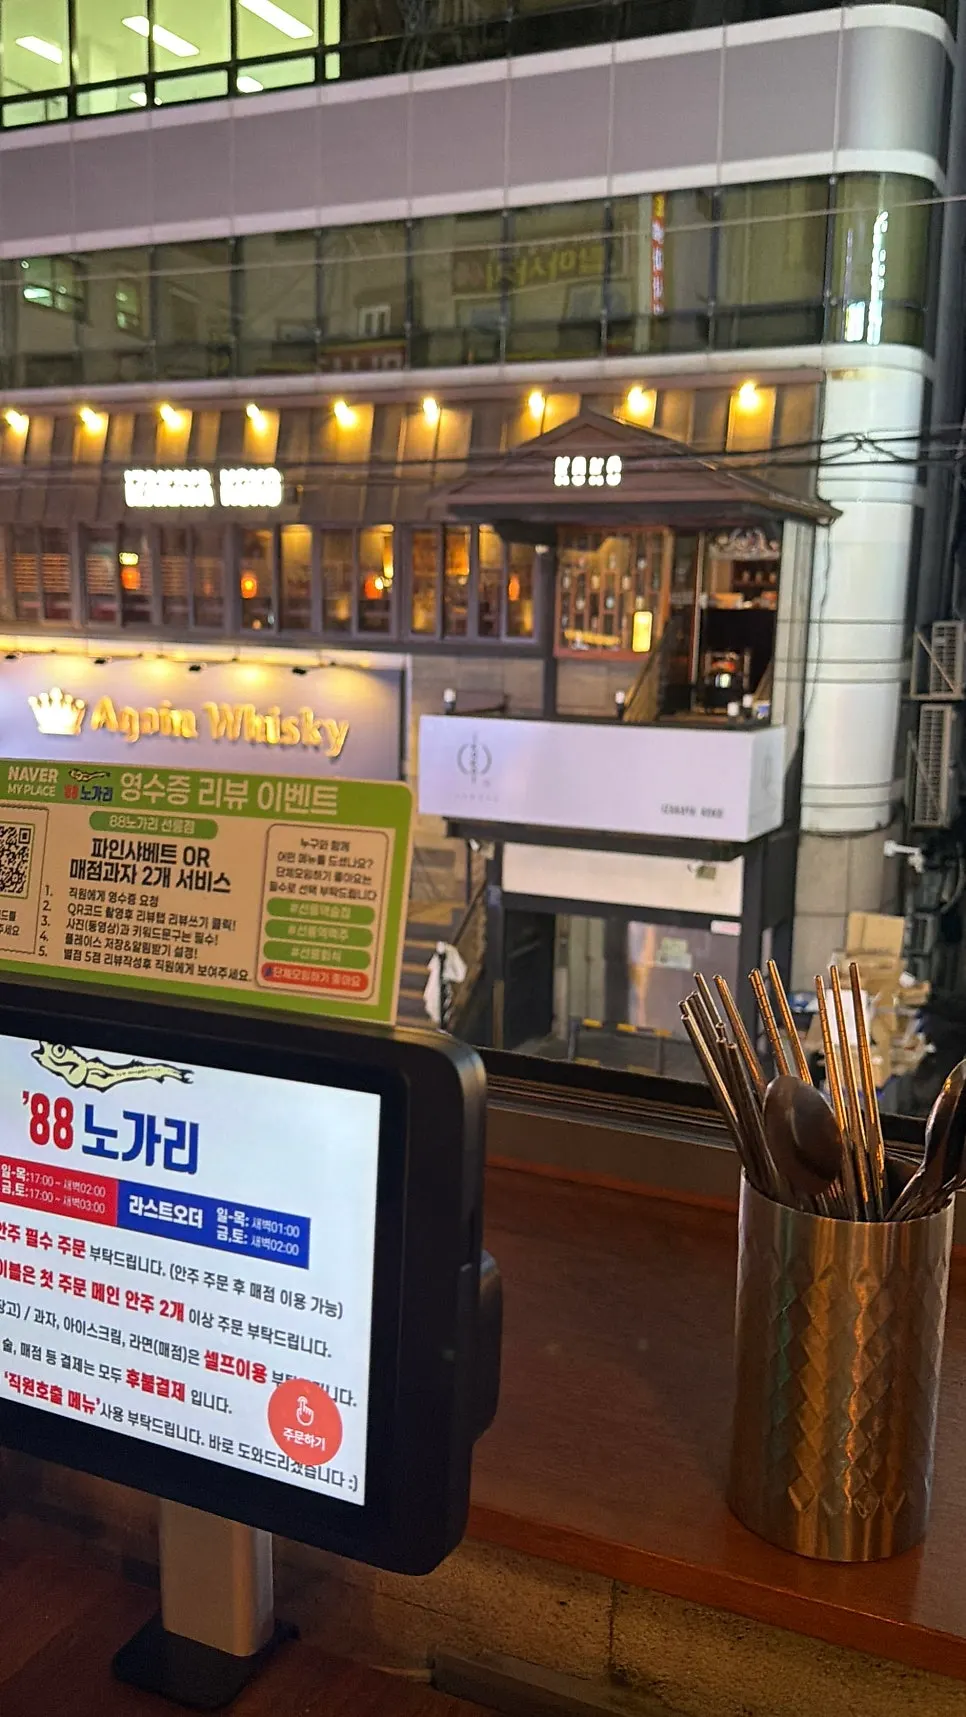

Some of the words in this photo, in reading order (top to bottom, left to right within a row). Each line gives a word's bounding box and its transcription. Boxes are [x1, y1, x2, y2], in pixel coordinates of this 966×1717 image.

[90, 695, 198, 742] Again
[203, 701, 349, 758] Whisky
[8, 766, 59, 783] NAVER
[81, 785, 113, 802] 노가리
[120, 772, 191, 805] 영수증
[198, 777, 248, 810] 리뷰
[257, 781, 338, 815] 이벤트
[110, 814, 158, 830] 88노가리
[91, 838, 177, 864] 파인샤베트
[182, 846, 210, 868] OR
[70, 858, 137, 885] 매점과자
[141, 866, 171, 888] 2개
[175, 868, 231, 893] 서비스
[45, 885, 53, 896] 1.
[69, 887, 105, 901] 직원에게
[108, 891, 136, 905] 영수증
[139, 894, 159, 907] 요청
[41, 915, 50, 927] 3.
[66, 918, 130, 936] 사진(동영상)과
[132, 925, 191, 943] 키워드문구는
[194, 932, 218, 946] 필수!
[67, 903, 102, 917] QR코드
[105, 906, 133, 920] 촬영후
[136, 909, 165, 924] 리뷰탭
[168, 913, 209, 929] 리뷰쓰기
[212, 918, 236, 931] 클릭!
[39, 931, 49, 942] 4.
[65, 932, 102, 949] 플레이스
[105, 938, 171, 957] 저장&알림받기
[174, 946, 198, 960] 설정!
[38, 946, 48, 957] 5.
[64, 948, 82, 961] 별점
[85, 951, 100, 963] 5점
[104, 953, 151, 969] 리뷰작성후
[155, 959, 194, 975] 직원에게
[197, 966, 252, 981] 보여주세요.
[82, 1104, 199, 1175] 노가리
[129, 1195, 203, 1229] 라스트오더
[216, 1207, 249, 1228] 일-목:
[250, 1217, 300, 1238] 새벽01:00
[216, 1225, 248, 1245] 금,토:
[250, 1235, 300, 1256] 새벽02:00
[25, 1228, 53, 1250] 필수
[58, 1235, 86, 1259] 주문
[90, 1245, 166, 1277] 부탁드립니다.
[170, 1263, 199, 1284] (안주
[203, 1271, 229, 1292] 주문
[233, 1278, 246, 1296] 후
[250, 1282, 275, 1303] 매점
[280, 1289, 306, 1310] 이용
[310, 1296, 343, 1320] 가능)
[40, 1269, 53, 1290] 첫
[58, 1273, 87, 1298] 주문
[91, 1281, 120, 1306] 메인
[125, 1290, 155, 1314] 안주
[159, 1300, 185, 1323] 2개
[189, 1308, 214, 1329] 이상
[217, 1315, 243, 1337] 주문
[247, 1322, 332, 1358] 부탁드립니다.
[34, 1308, 60, 1330] 과자,
[63, 1316, 125, 1347] 아이스크림,
[129, 1333, 200, 1366] 라면(매점)은
[204, 1349, 267, 1384] 셀프이용
[20, 1342, 42, 1361] 매점
[46, 1349, 57, 1365] 등
[60, 1353, 95, 1377] 결제는
[98, 1363, 122, 1383] 모두
[125, 1369, 186, 1402] 후불결제
[191, 1389, 232, 1414] 입니다.
[127, 1410, 204, 1446] 부탁드립니다.
[208, 1434, 234, 1455] 바로
[283, 1427, 325, 1451] 주문하기
